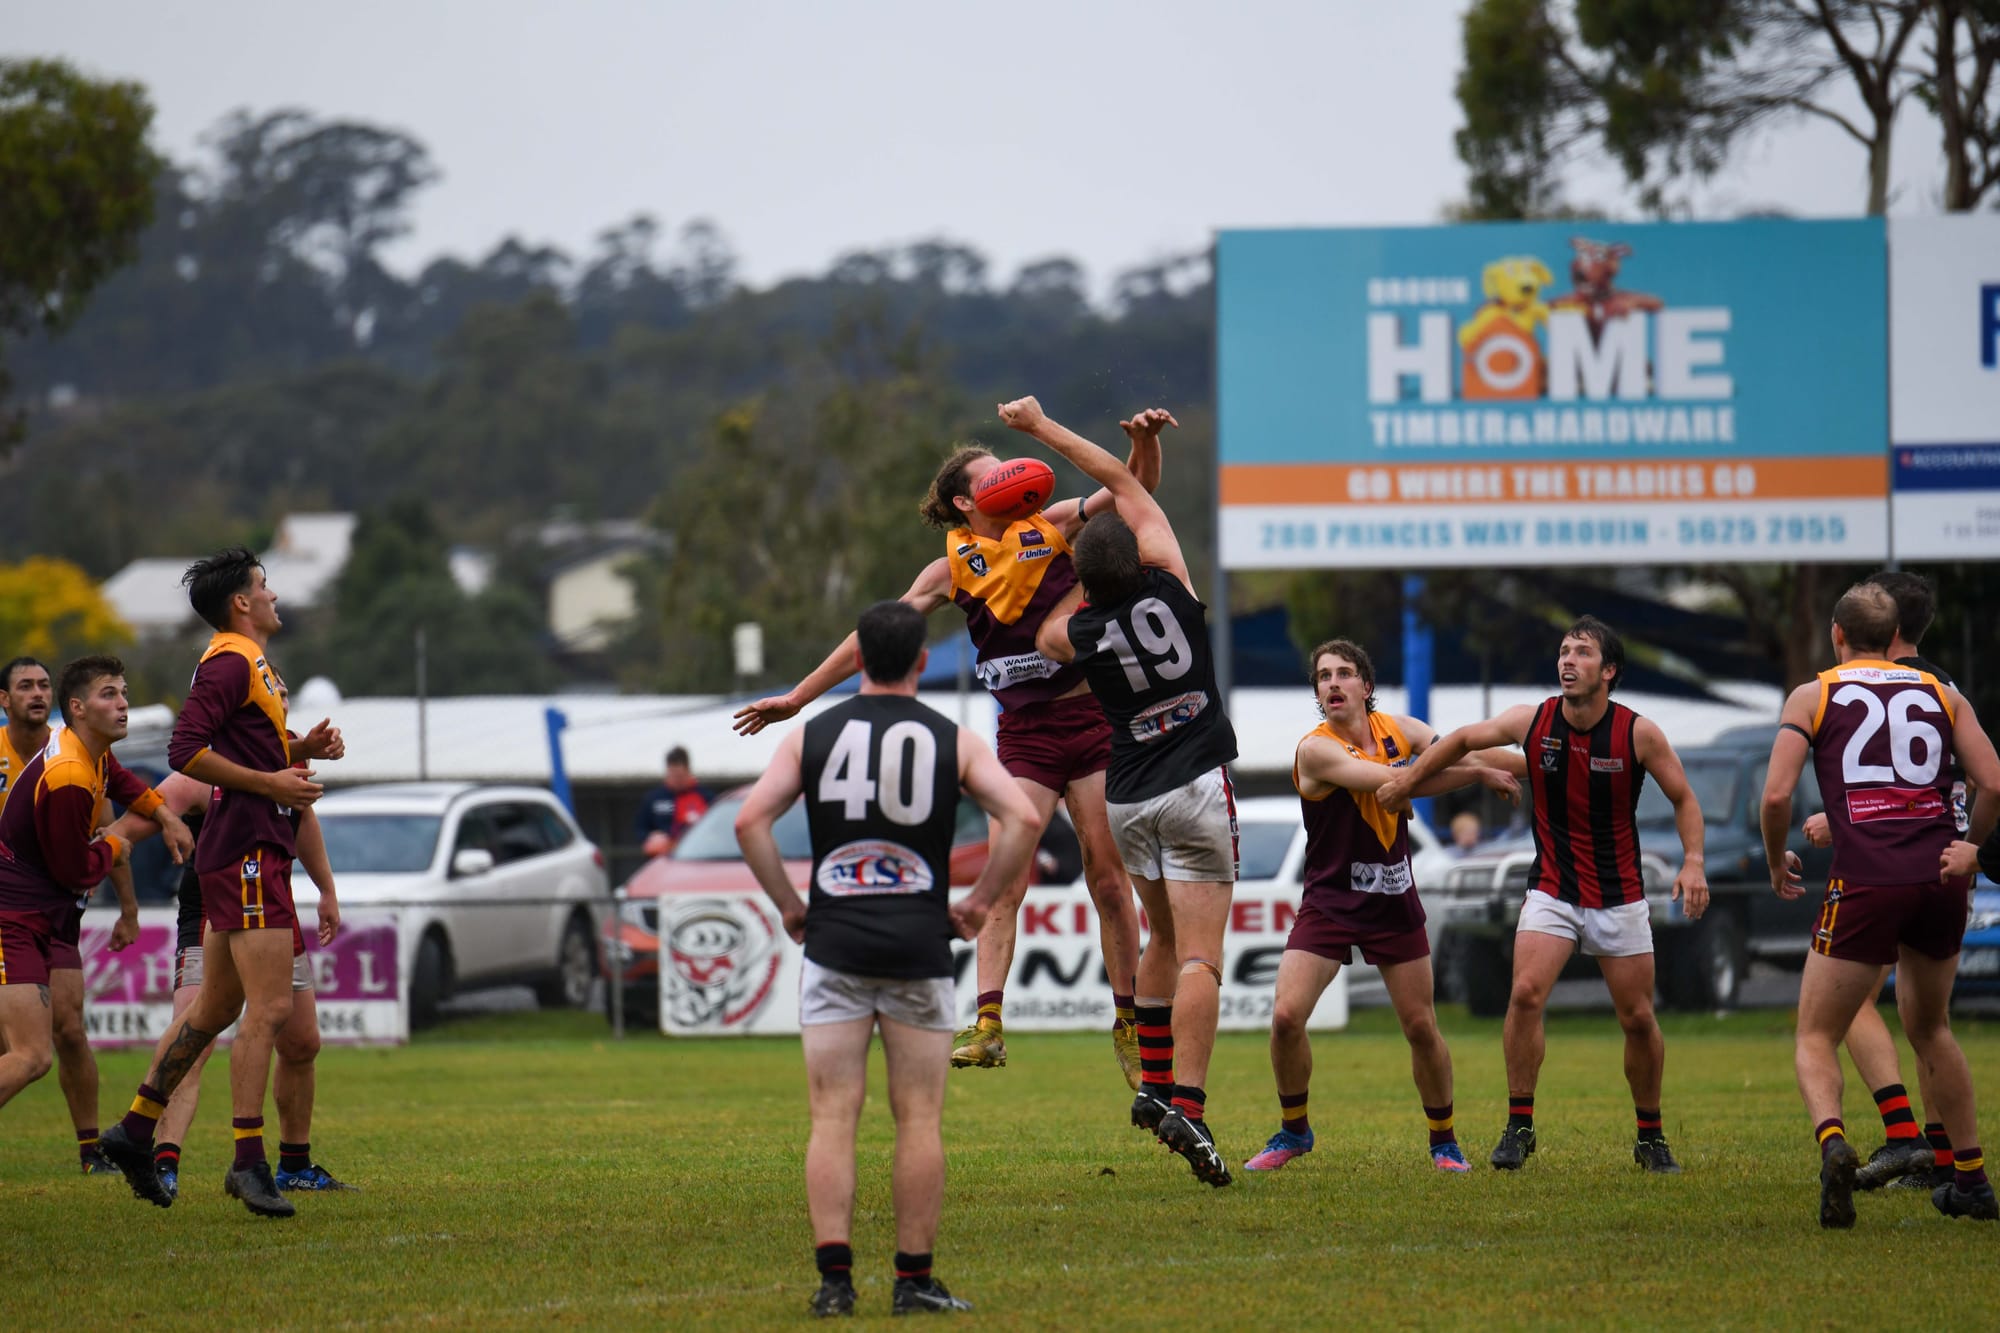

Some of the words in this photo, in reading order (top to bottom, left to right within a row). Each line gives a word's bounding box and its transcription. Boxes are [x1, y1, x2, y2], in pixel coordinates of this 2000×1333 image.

[1367, 278, 1470, 304] DROUIN
[1366, 307, 1733, 405] HOME
[1346, 468, 1392, 501] GO
[1396, 467, 1504, 500] WHERE
[1513, 467, 1568, 498] THE
[1574, 464, 1705, 497] TRADIES
[1713, 463, 1756, 496] GO
[1326, 519, 1452, 548] PRINCES
[1461, 518, 1526, 547] WAY
[1534, 517, 1649, 546] DROUIN
[1025, 547, 1052, 559] United
[1096, 596, 1194, 694] 19
[1006, 661, 1046, 677] RENAUL
[1831, 683, 1943, 786] 26
[818, 718, 937, 827] 40
